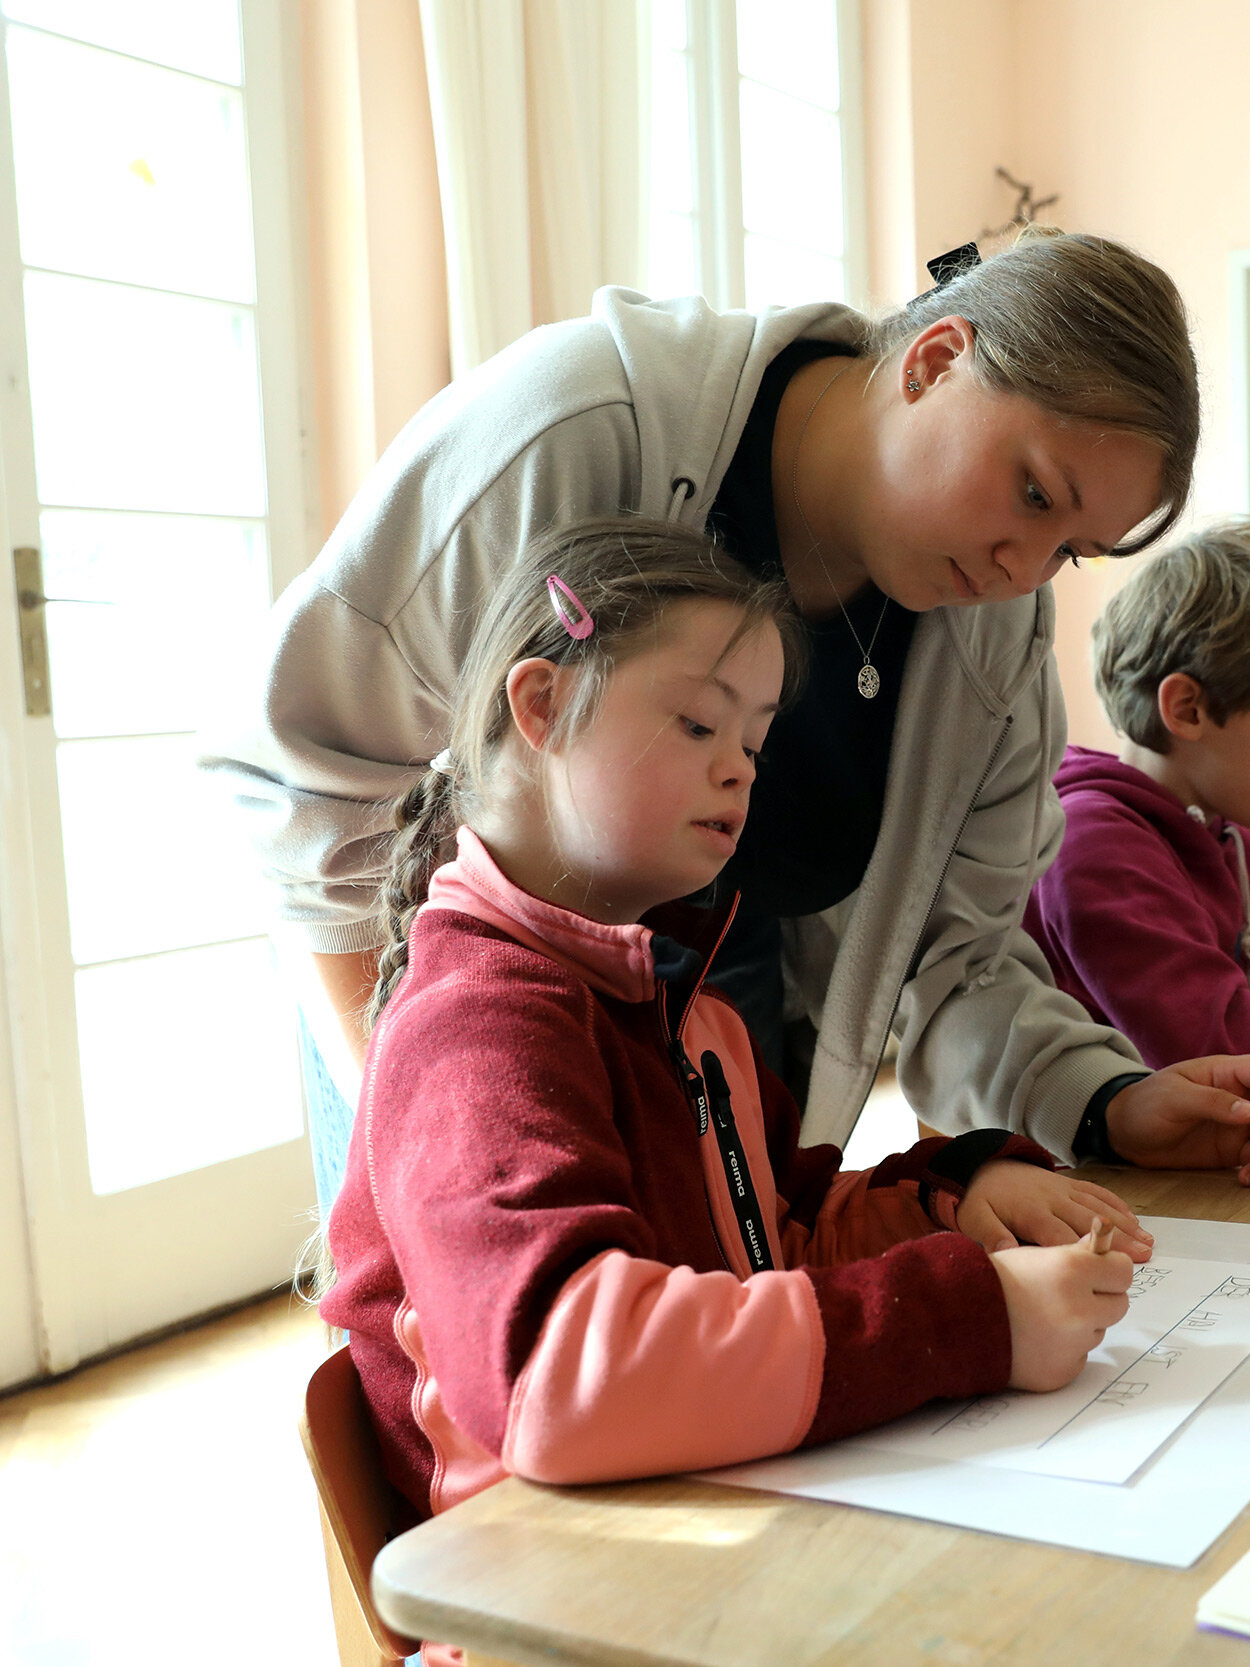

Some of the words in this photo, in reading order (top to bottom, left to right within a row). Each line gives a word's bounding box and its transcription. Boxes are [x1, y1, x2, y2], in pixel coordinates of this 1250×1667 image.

[698, 1095, 707, 1134] reima
[728, 1150, 745, 1197] reima
[745, 1219, 763, 1266] reima
